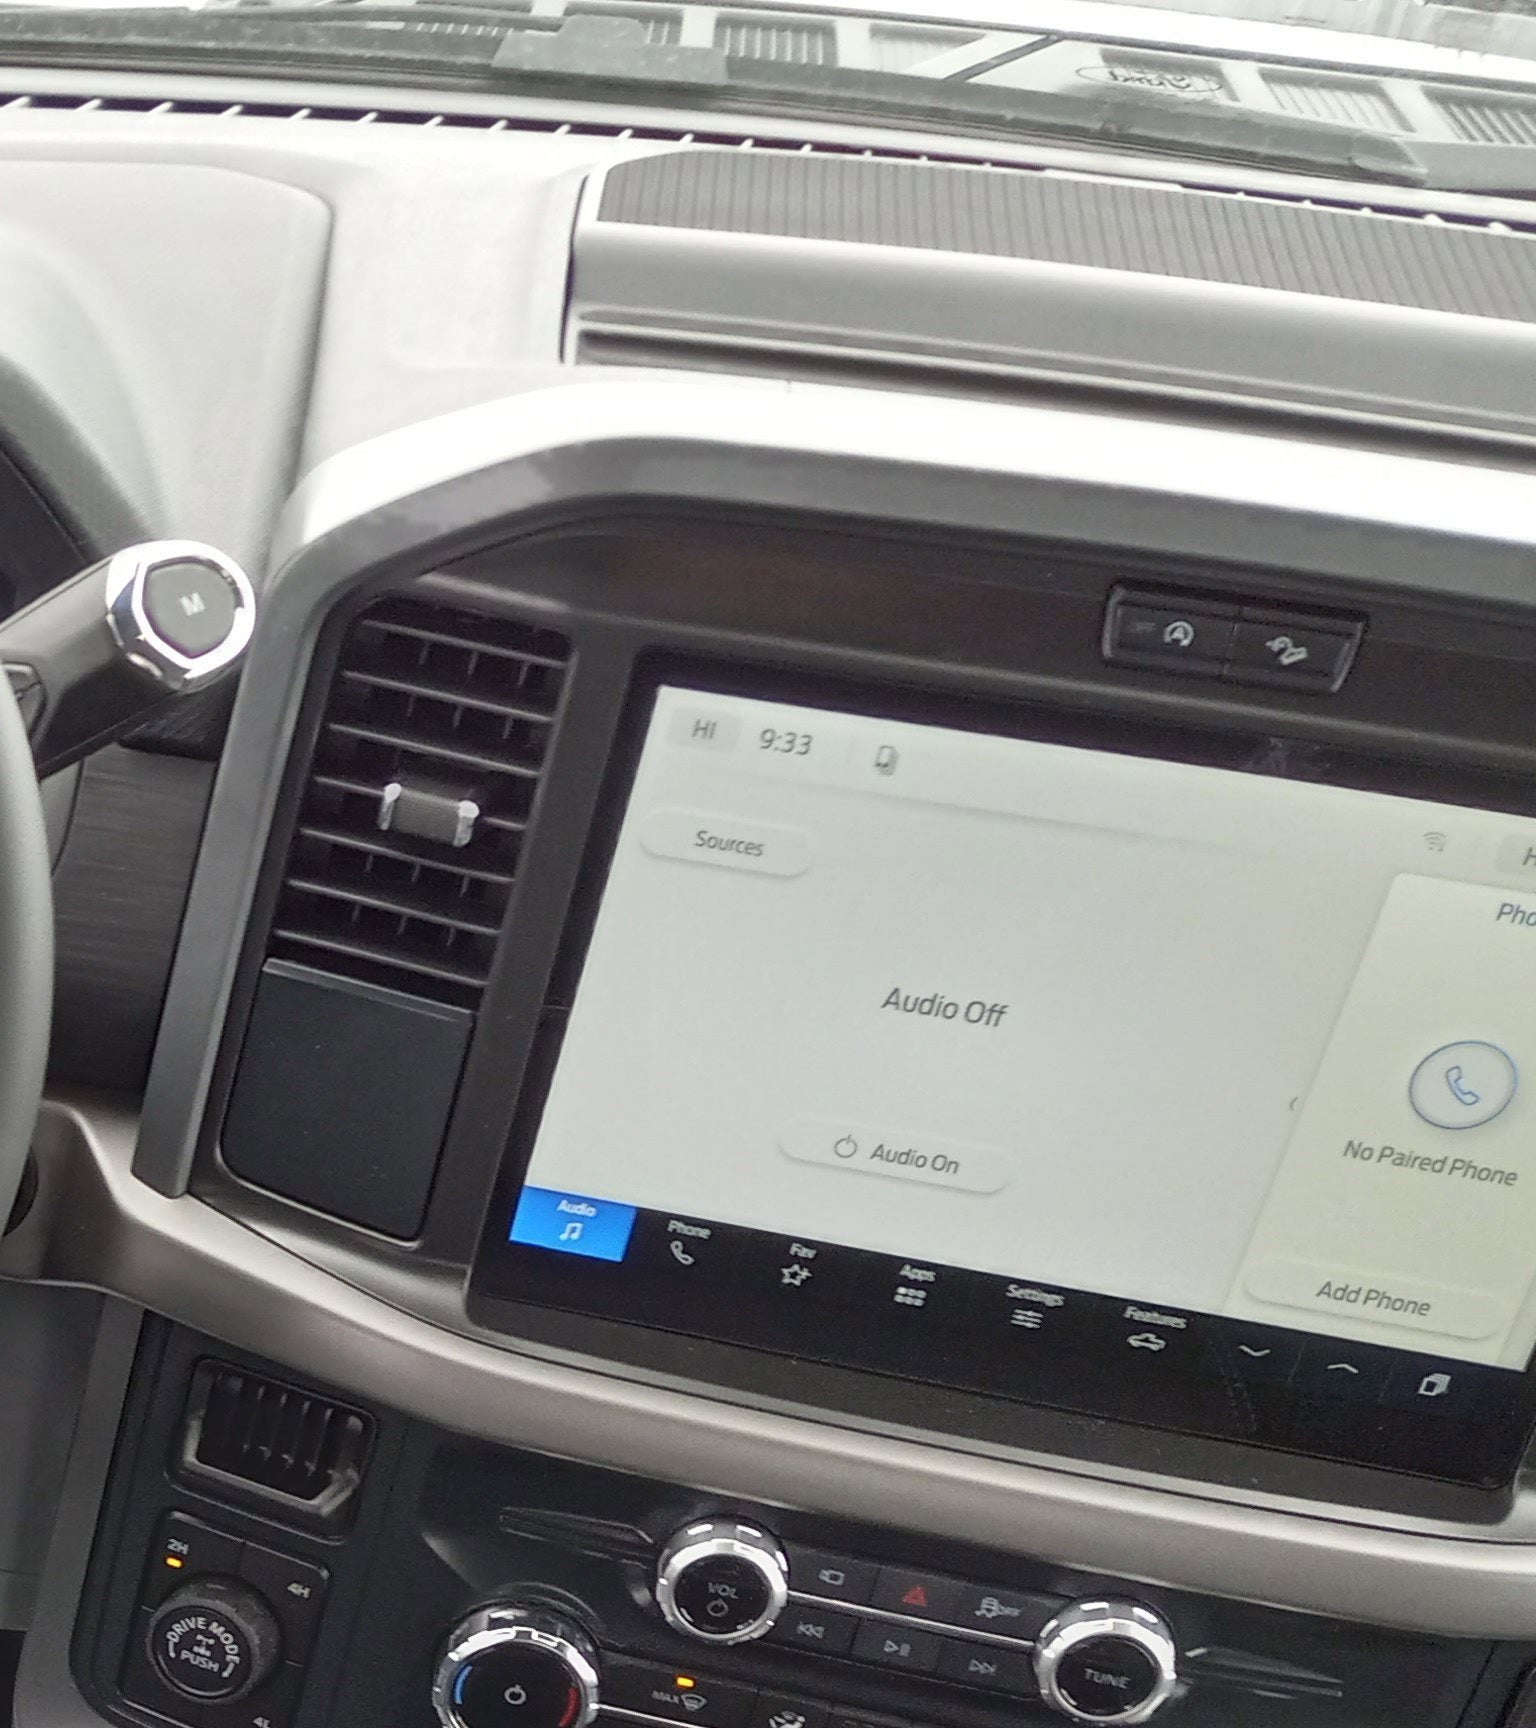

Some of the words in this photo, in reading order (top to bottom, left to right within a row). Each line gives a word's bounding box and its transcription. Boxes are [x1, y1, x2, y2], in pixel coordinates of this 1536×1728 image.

[758, 728, 814, 756] 9:33
[693, 829, 766, 858] Sources
[1496, 902, 1536, 927] Pho
[881, 986, 959, 1020] Audio
[963, 1000, 1010, 1028] Off
[870, 1143, 928, 1168] Audio
[930, 1154, 961, 1176] On
[1342, 1139, 1375, 1162] No
[1376, 1146, 1449, 1174] Paired
[1447, 1158, 1519, 1188] Phone
[556, 1198, 599, 1218] Audio
[666, 1218, 713, 1241] Phone
[1315, 1280, 1362, 1304] Add
[1362, 1288, 1432, 1318] Phone
[286, 1581, 312, 1600] 4H
[165, 1615, 208, 1644] DRIVE
[207, 1620, 242, 1665] MODE
[180, 1648, 221, 1673] PUSH
[1083, 1666, 1130, 1690] TUNE
